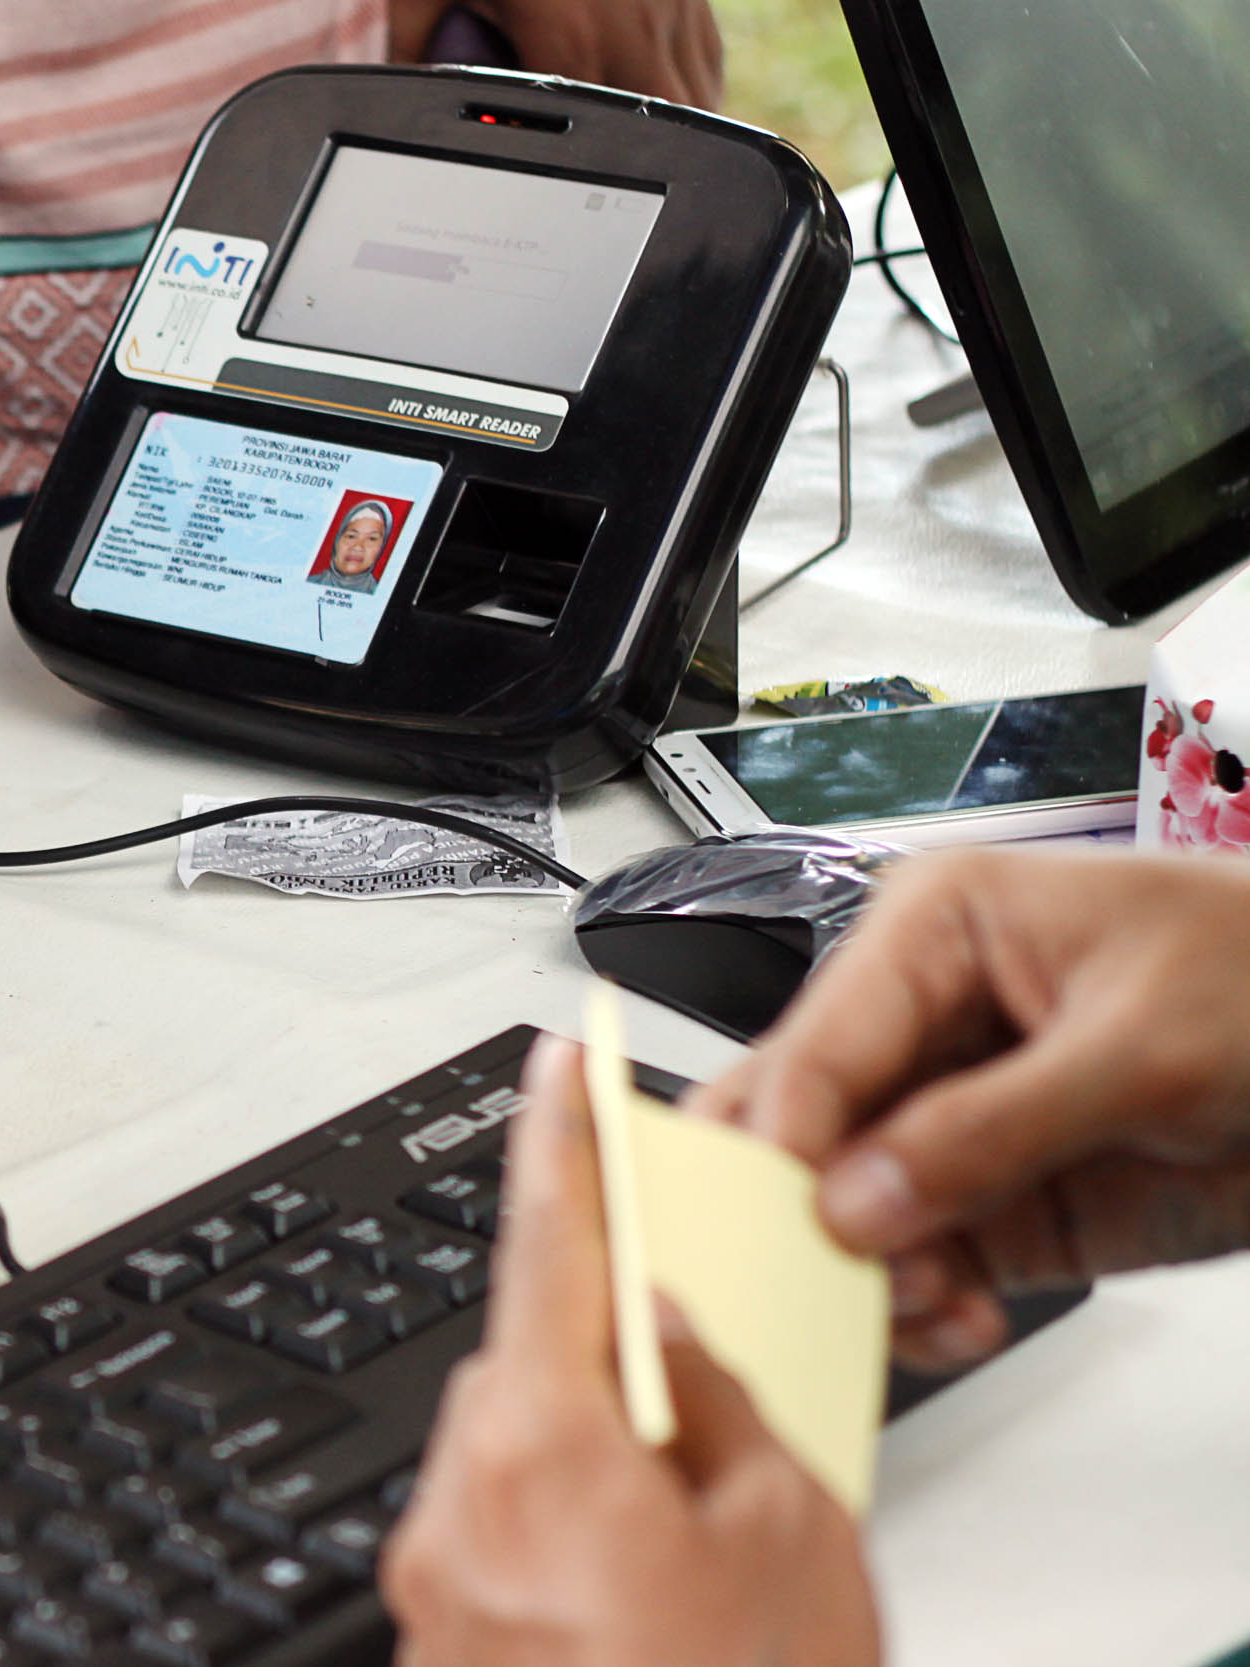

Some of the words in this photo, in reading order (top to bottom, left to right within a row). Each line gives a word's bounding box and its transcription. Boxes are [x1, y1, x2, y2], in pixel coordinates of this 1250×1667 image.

[164, 241, 254, 286] INTI
[388, 397, 423, 416] INTI
[423, 405, 479, 427] SMART
[479, 415, 542, 440] READER
[143, 444, 168, 457] NIK
[241, 435, 289, 451] PROVINSI
[288, 444, 317, 457] JAWA
[316, 449, 353, 463] BARAT
[242, 446, 304, 465] KABUPATEN
[302, 457, 341, 473] BOGOR
[248, 571, 283, 585] TANGGA
[341, 866, 455, 887] REPUBLIK
[390, 878, 455, 890] KARTU
